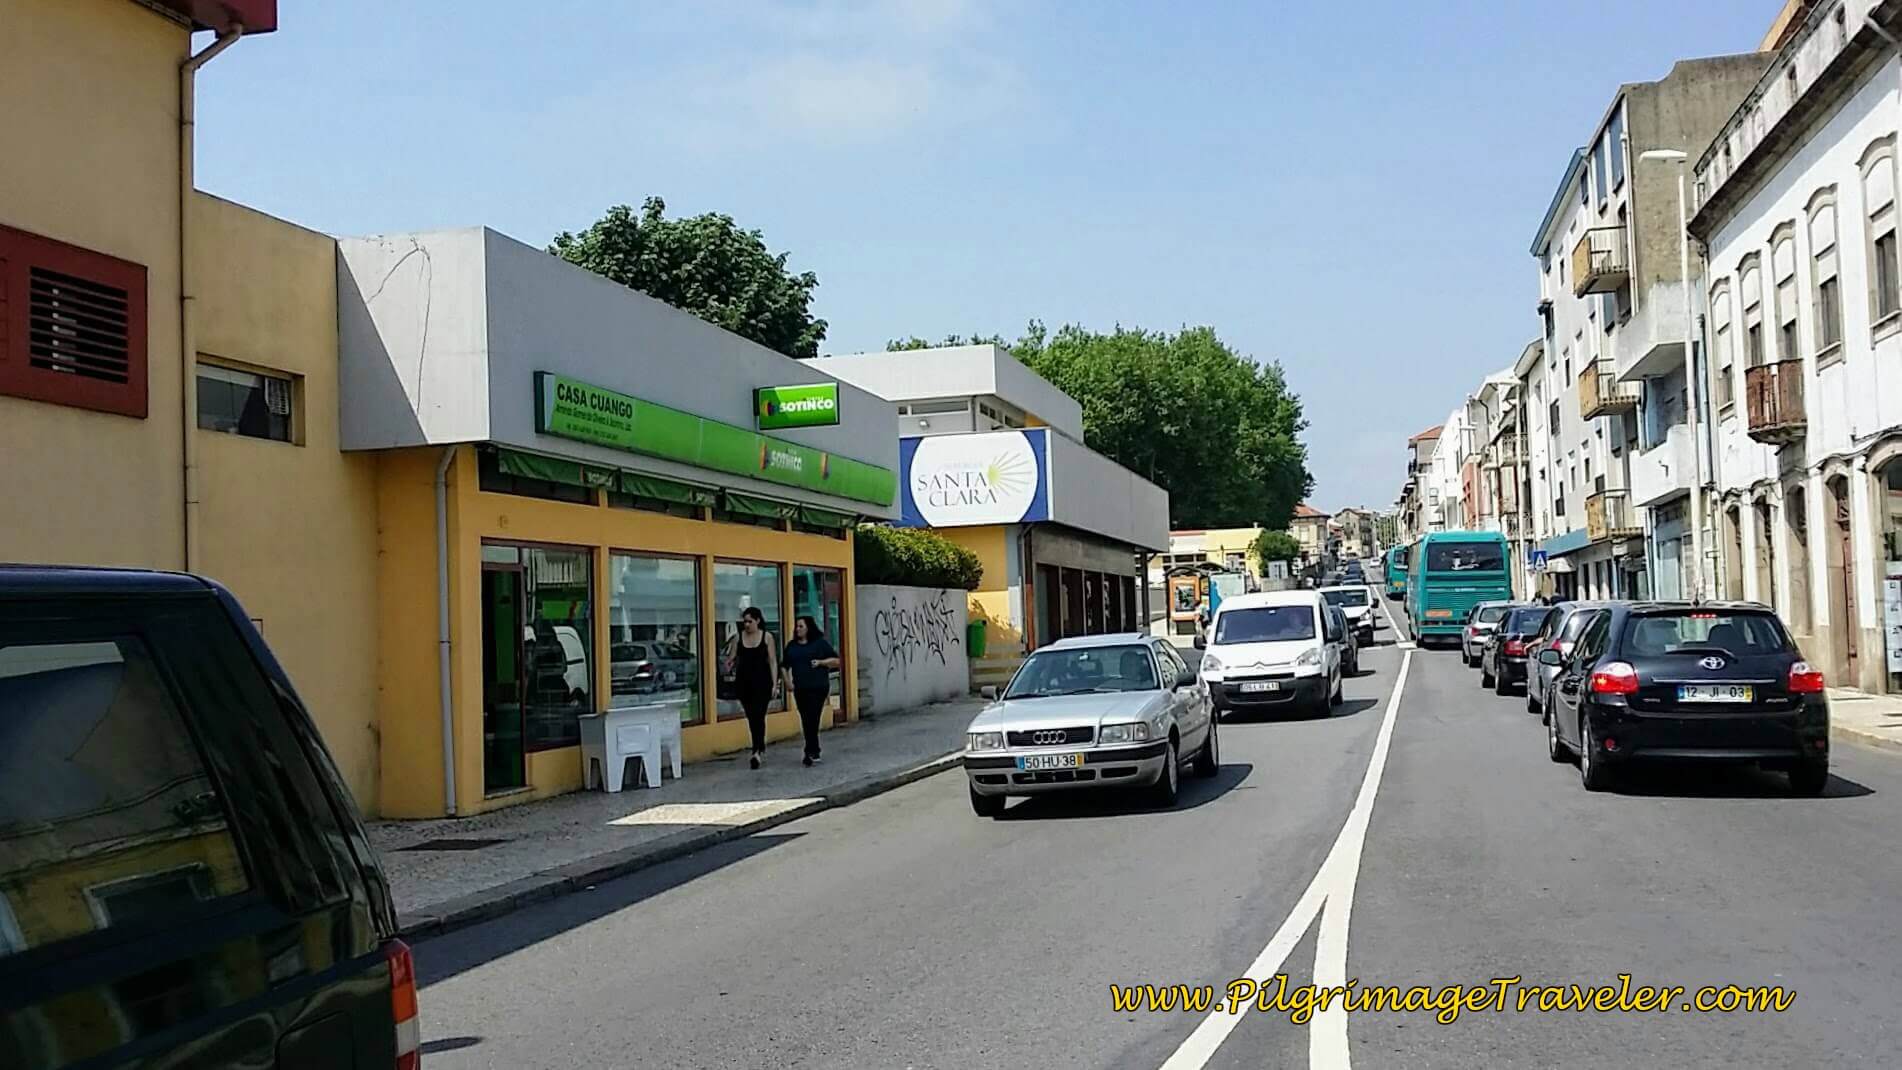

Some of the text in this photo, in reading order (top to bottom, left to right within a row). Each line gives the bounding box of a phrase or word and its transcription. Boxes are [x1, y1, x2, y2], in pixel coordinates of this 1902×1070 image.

[557, 383, 587, 407] CASA
[590, 393, 632, 419] CUANGO
[918, 471, 987, 491] SANTA
[928, 489, 997, 507] CLARA
